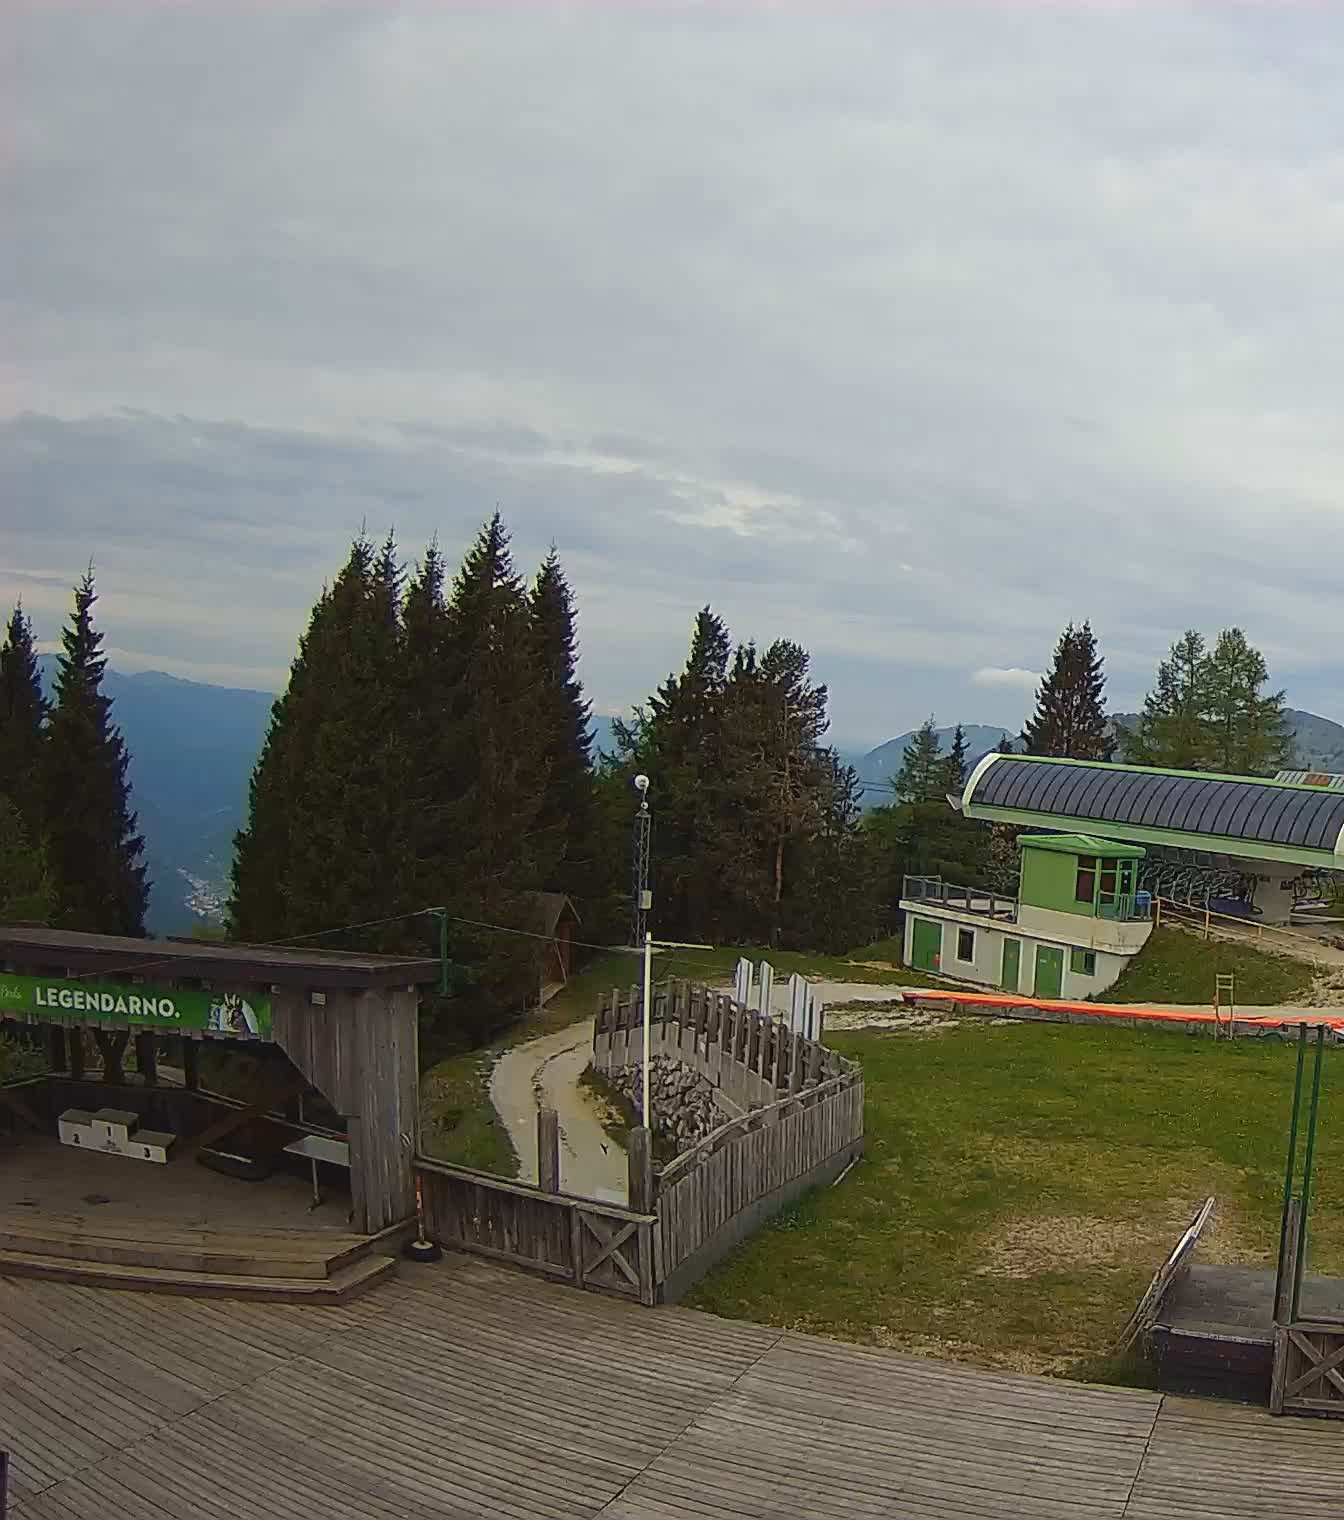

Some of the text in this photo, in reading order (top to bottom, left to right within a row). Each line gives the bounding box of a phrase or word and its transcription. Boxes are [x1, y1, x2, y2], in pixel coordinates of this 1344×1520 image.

[35, 985, 181, 1019] LEGENDARNO.
[73, 1133, 80, 1144] 2
[144, 1147, 151, 1158] 3
